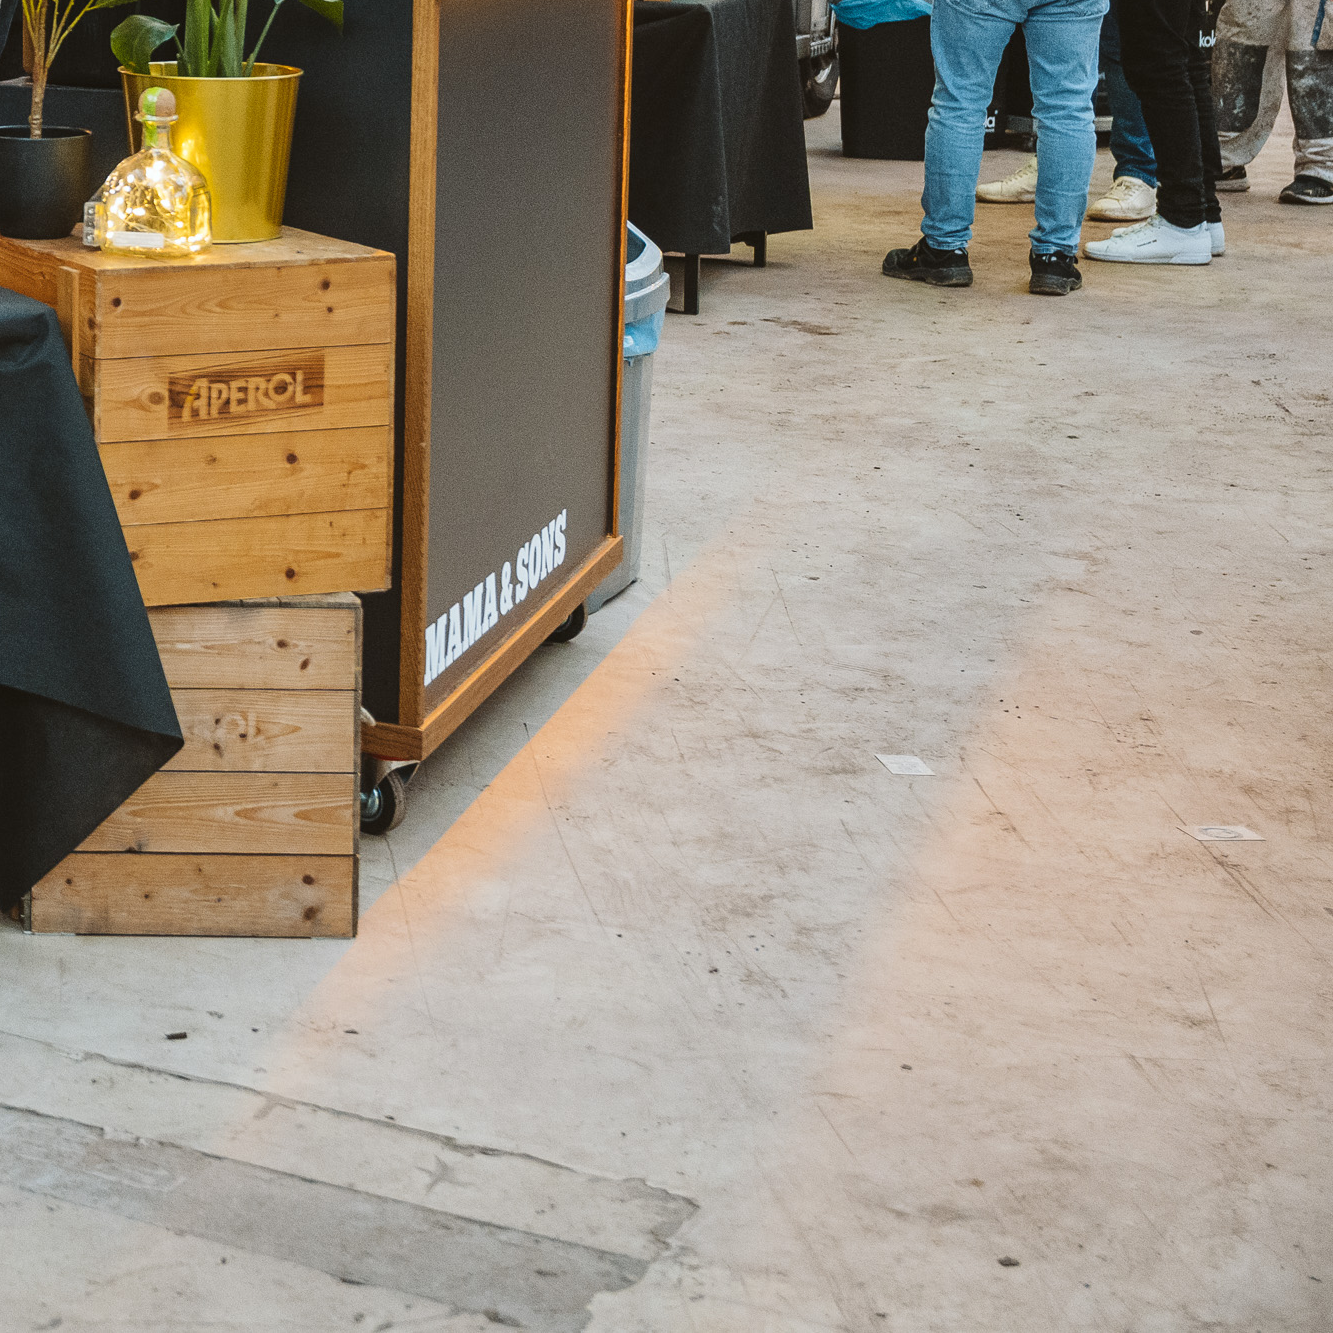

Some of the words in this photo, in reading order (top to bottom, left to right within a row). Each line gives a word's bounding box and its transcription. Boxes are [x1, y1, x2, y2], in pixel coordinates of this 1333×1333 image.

[182, 369, 313, 422] APEROL
[424, 571, 499, 688] MAMA
[499, 561, 514, 617] &
[515, 508, 568, 605] SONS
